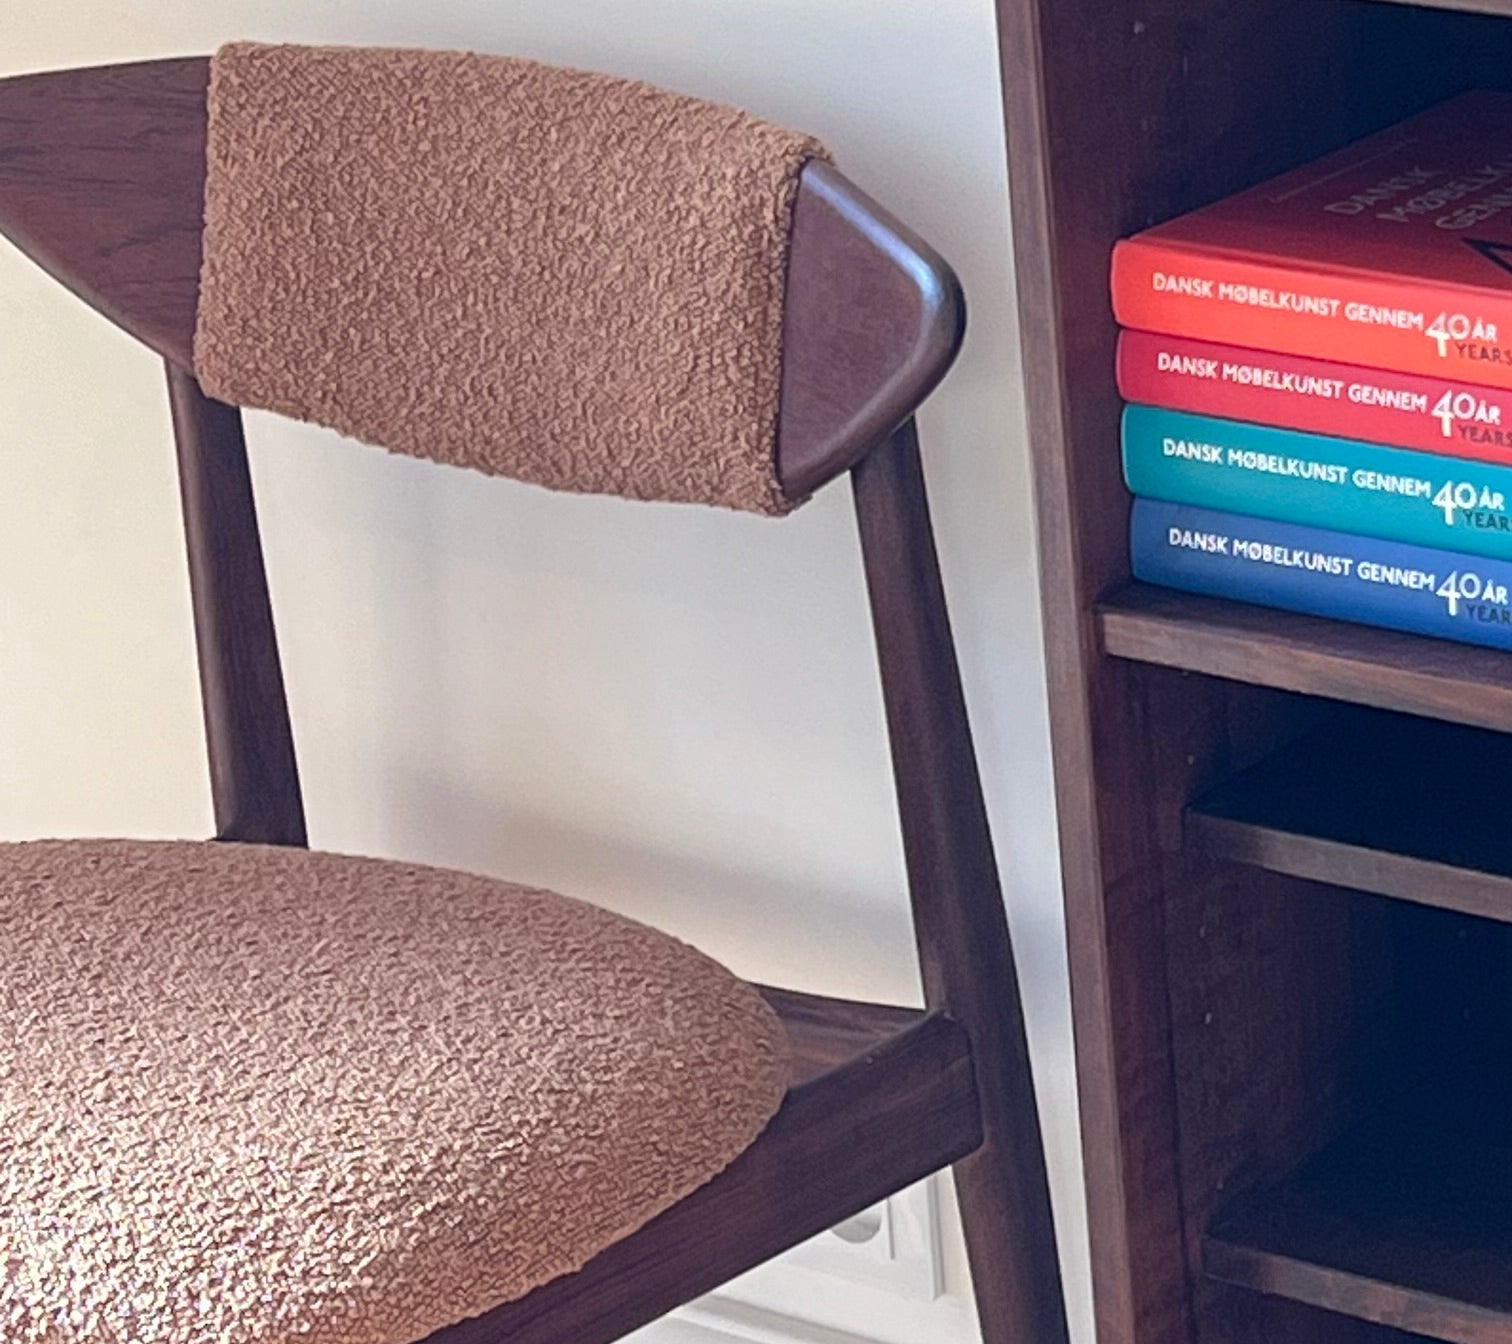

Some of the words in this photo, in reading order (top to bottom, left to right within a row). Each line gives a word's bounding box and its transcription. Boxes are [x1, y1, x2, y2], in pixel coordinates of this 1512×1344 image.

[1324, 166, 1444, 215] DANSK
[1152, 272, 1213, 298] DANSK
[1220, 282, 1340, 317] MØBELKUNST
[1345, 302, 1424, 331] GENNEM
[1424, 312, 1471, 357] 40
[1471, 318, 1498, 343] ÅR
[1454, 342, 1512, 367] YEARS
[1157, 352, 1218, 378] DANSK
[1222, 363, 1344, 398] MØBELKUNST
[1348, 383, 1427, 412] GENNEM
[1431, 390, 1476, 437] 40
[1476, 400, 1501, 425] ÅR
[1162, 438, 1223, 465] DANSK
[1228, 449, 1348, 485] MØBELKUNST
[1352, 470, 1431, 499] GENNEM
[1432, 481, 1477, 525] 40
[1478, 485, 1504, 511] ÅR
[1169, 528, 1228, 554] DANSK
[1232, 539, 1353, 576] MØBELKUNST
[1357, 561, 1435, 591] GENNEM
[1436, 570, 1481, 616] 40
[1481, 579, 1508, 605] ÅR
